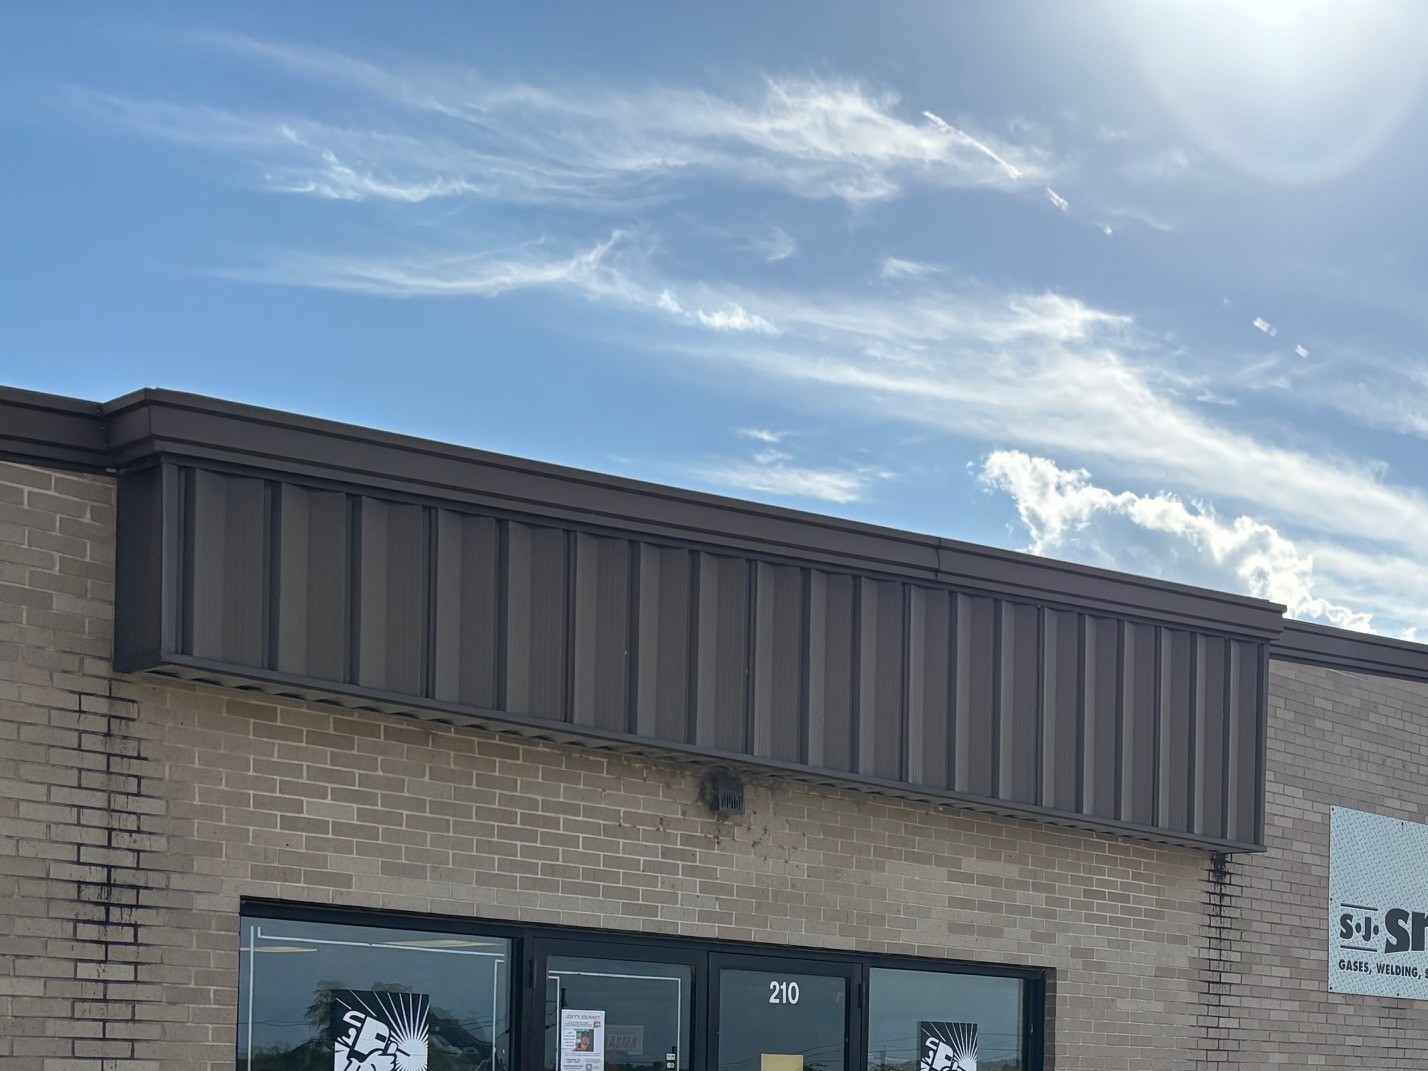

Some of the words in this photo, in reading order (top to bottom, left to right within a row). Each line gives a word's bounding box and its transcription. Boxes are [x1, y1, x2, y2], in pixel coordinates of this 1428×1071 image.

[1338, 959, 1372, 976] GASES,
[1376, 963, 1422, 980] WELDING,
[769, 981, 800, 1004] 210
